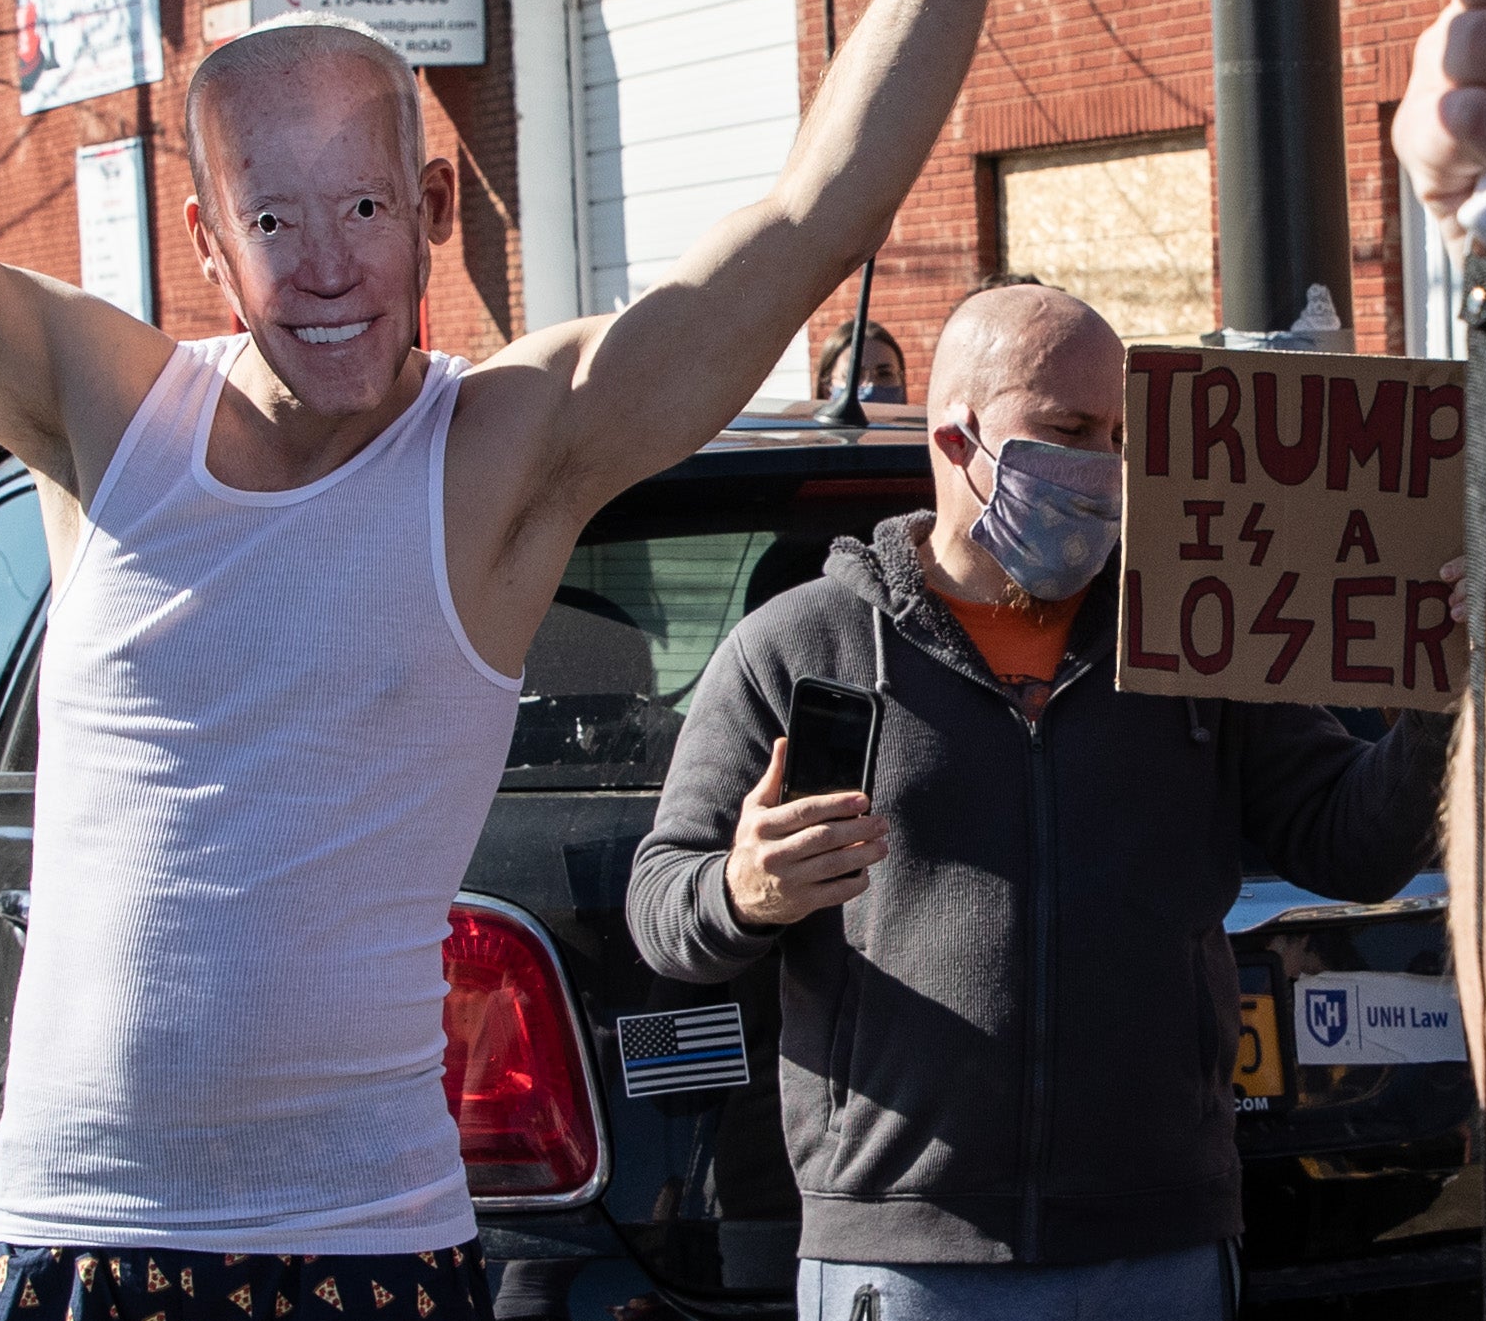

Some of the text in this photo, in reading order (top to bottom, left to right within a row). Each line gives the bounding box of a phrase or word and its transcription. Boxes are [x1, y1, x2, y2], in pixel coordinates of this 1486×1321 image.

[406, 39, 452, 52] ROAD
[1129, 350, 1465, 499] TRUMP
[1178, 499, 1381, 567] IS A
[1126, 568, 1454, 693] LOSER
[1367, 1005, 1449, 1029] UNH Law
